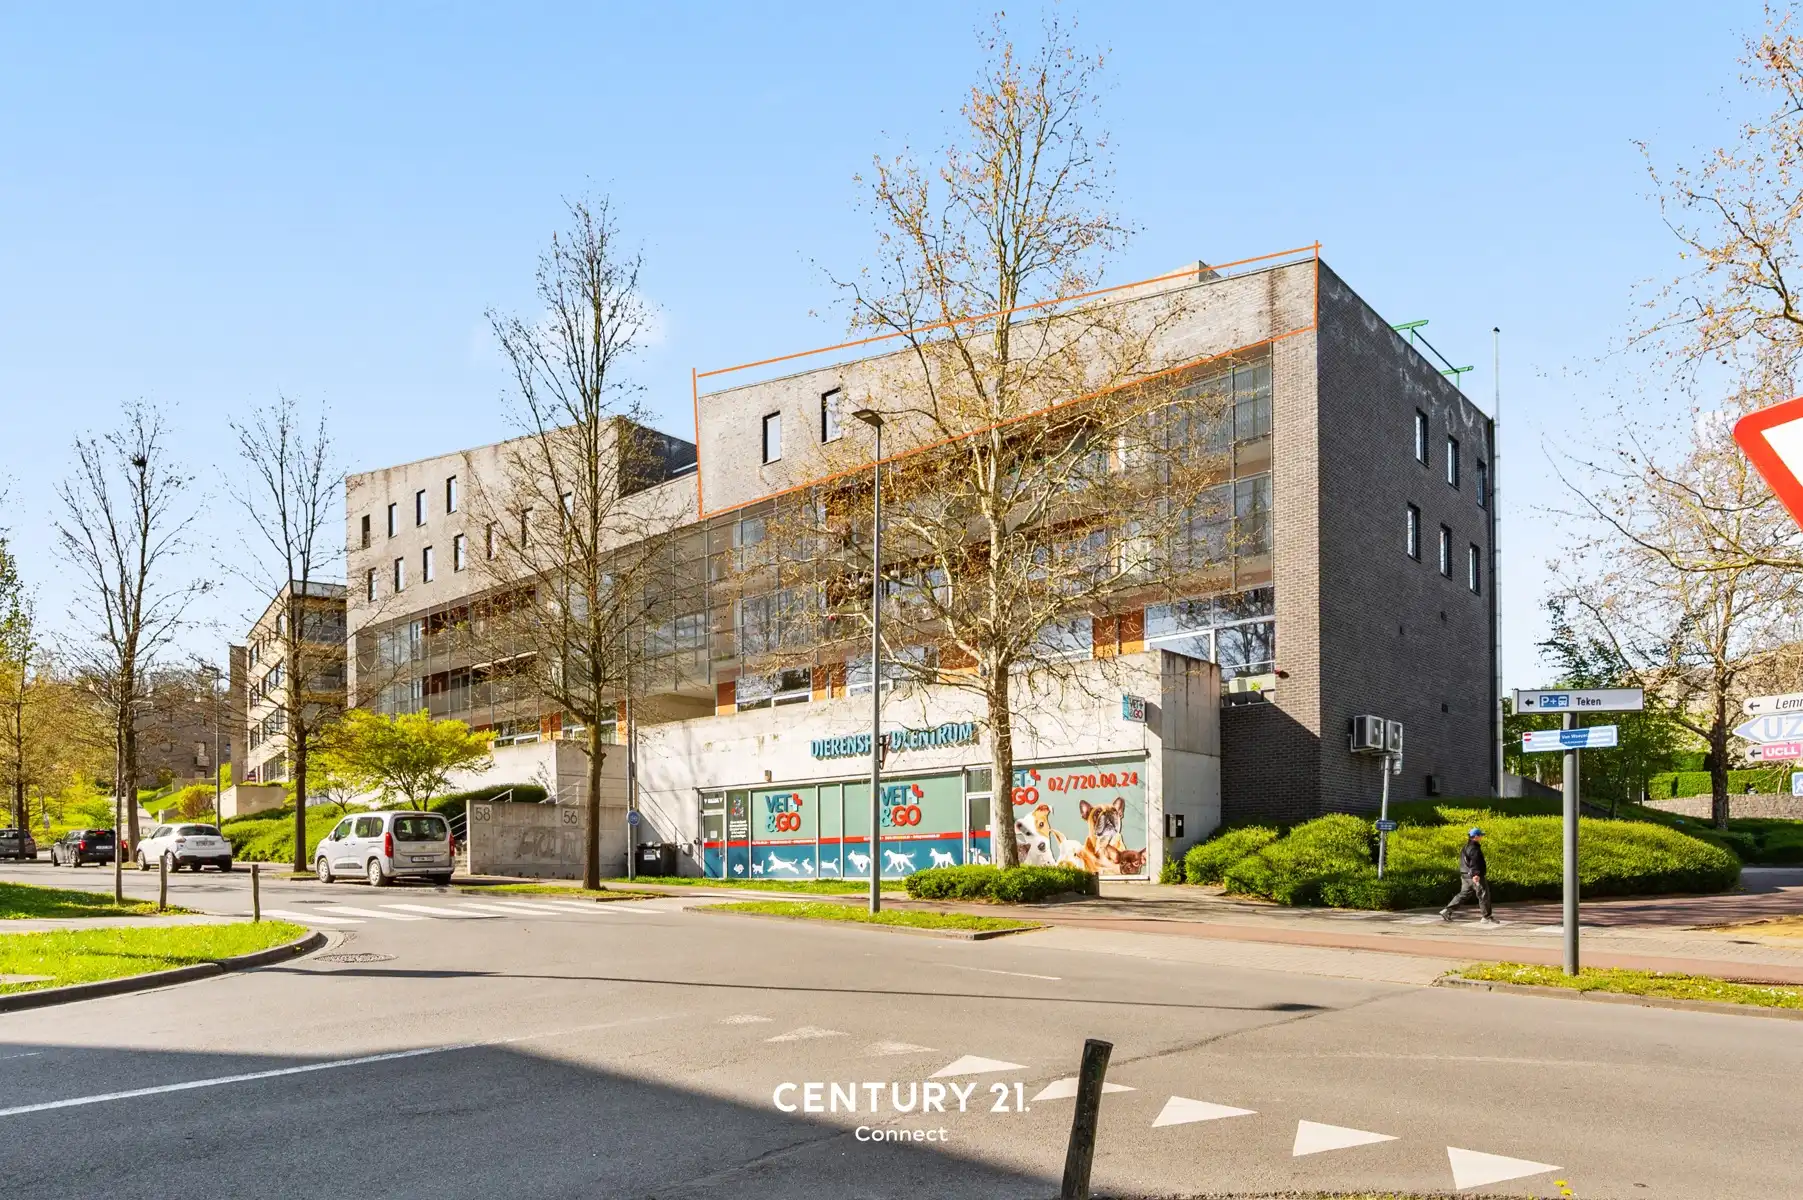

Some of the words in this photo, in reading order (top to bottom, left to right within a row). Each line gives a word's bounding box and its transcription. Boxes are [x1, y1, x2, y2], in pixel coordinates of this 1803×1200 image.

[1576, 697, 1602, 706] Teken
[1766, 746, 1799, 757] UCLL
[1012, 769, 1029, 788] ET
[1047, 771, 1138, 795] 02/720.00.24
[765, 793, 792, 814] VET
[880, 785, 911, 807] VET
[475, 807, 491, 822] 58
[563, 810, 578, 824] 56
